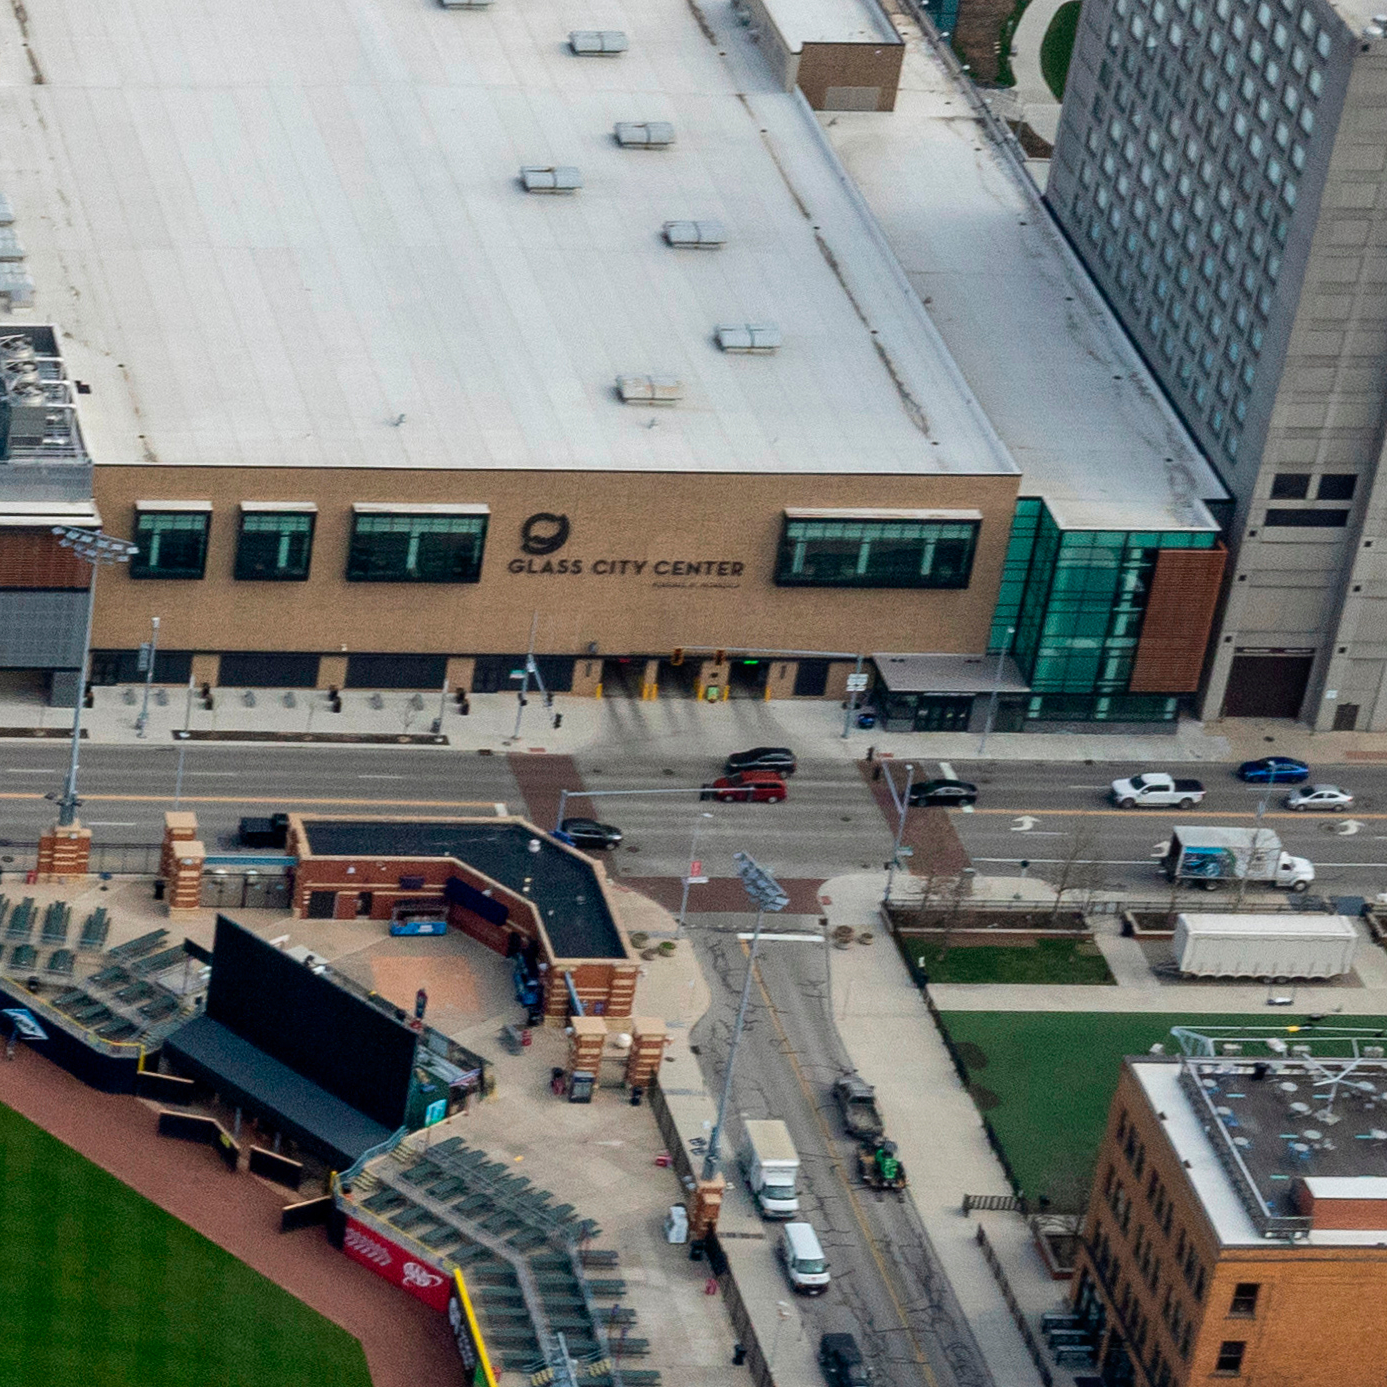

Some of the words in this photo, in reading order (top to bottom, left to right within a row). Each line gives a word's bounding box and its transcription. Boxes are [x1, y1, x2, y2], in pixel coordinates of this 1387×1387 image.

[508, 559, 583, 575] GLASS
[592, 560, 648, 576] CITY
[654, 560, 745, 577] CENTER
